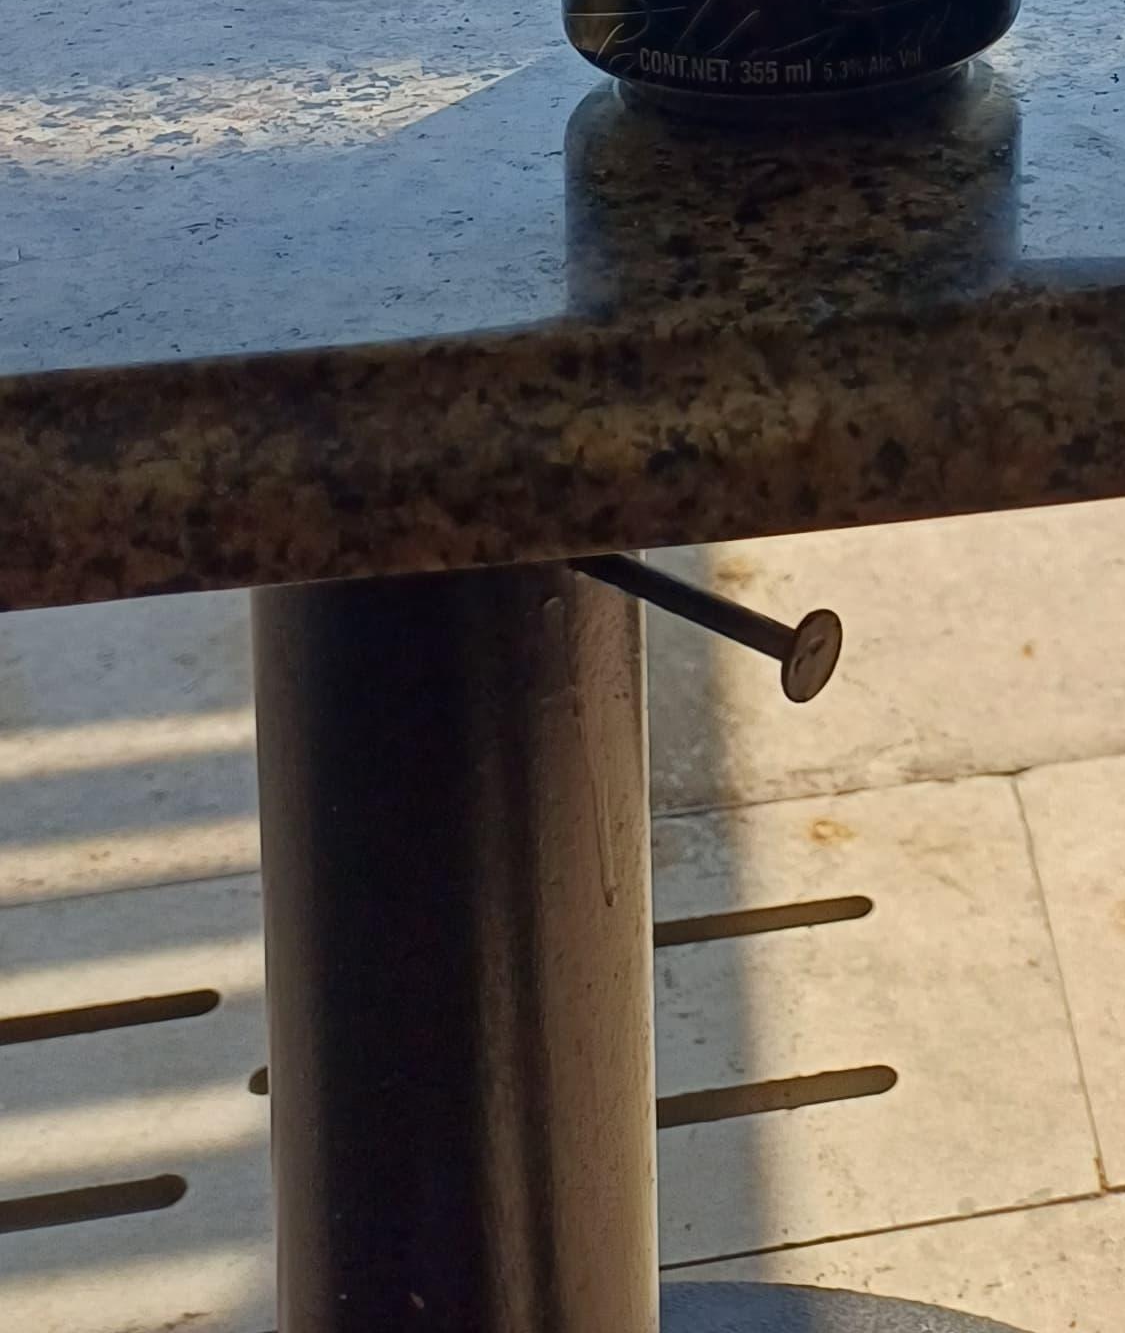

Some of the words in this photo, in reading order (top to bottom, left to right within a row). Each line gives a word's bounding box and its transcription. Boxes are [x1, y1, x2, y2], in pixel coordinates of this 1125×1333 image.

[638, 47, 734, 84] CONT.NET.
[739, 62, 778, 85] 355
[785, 59, 812, 84] ml
